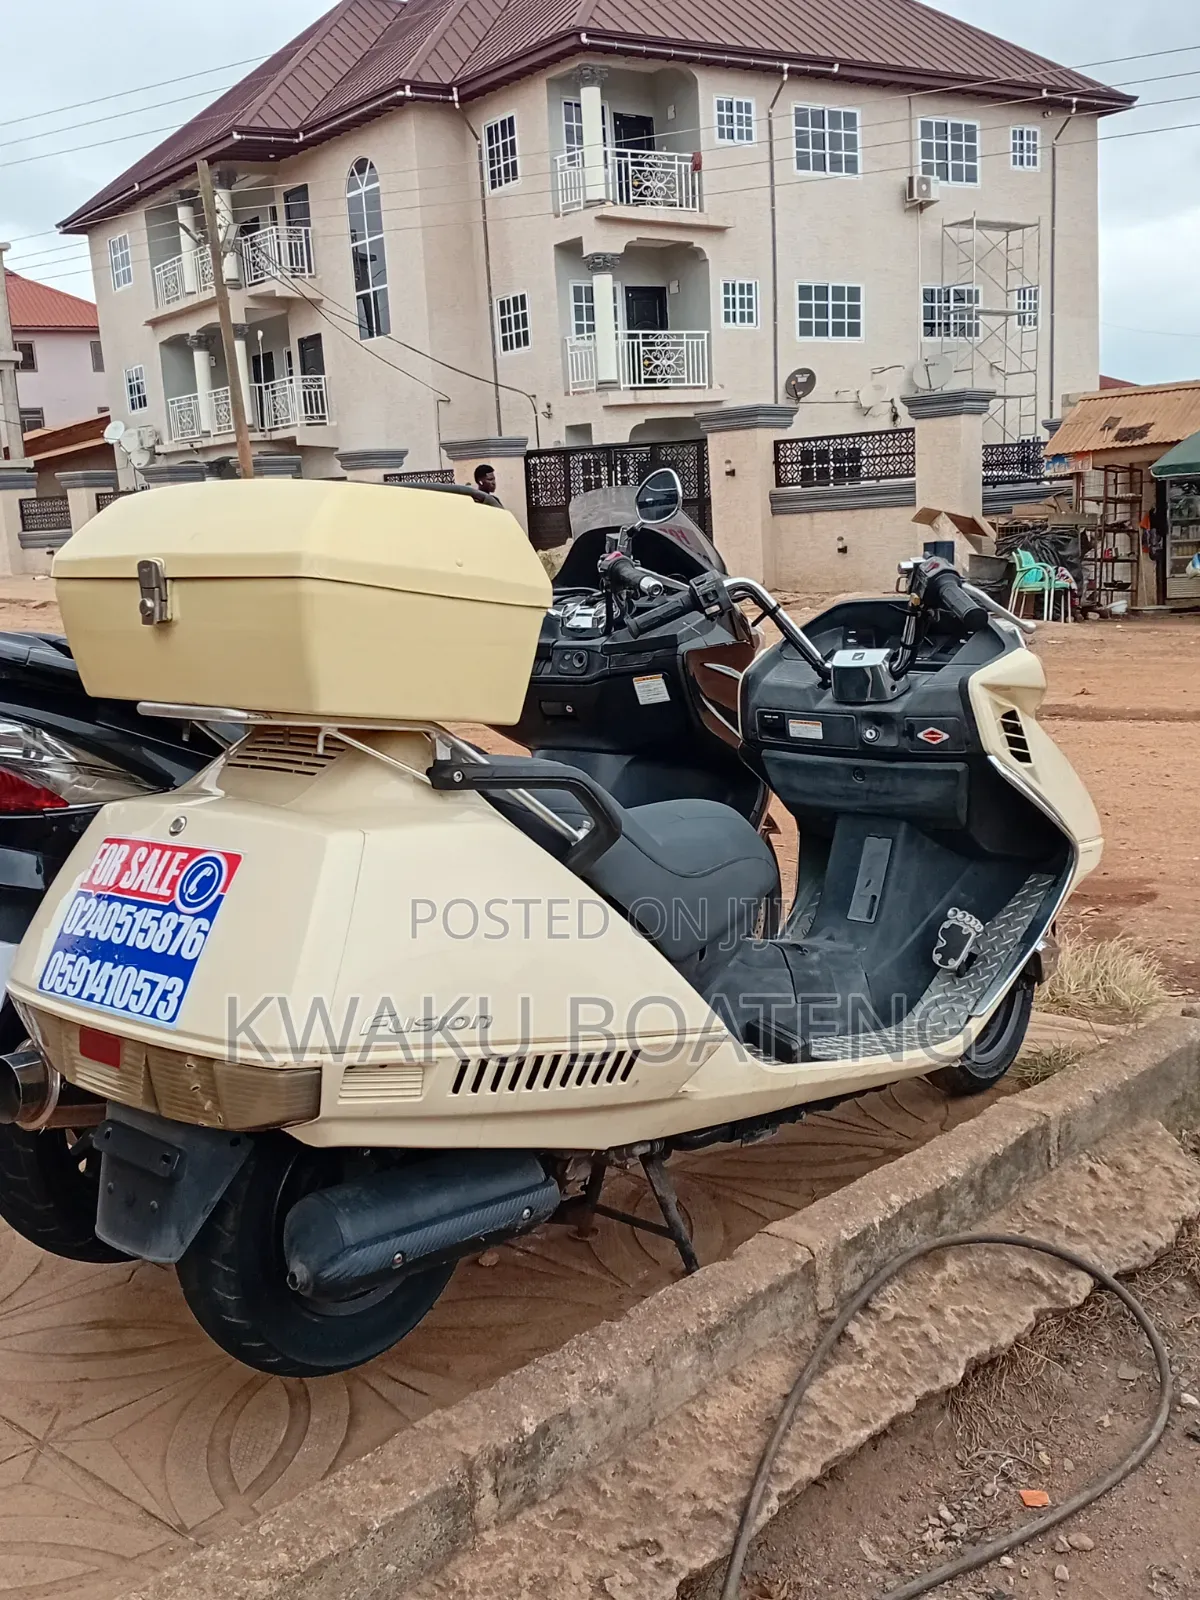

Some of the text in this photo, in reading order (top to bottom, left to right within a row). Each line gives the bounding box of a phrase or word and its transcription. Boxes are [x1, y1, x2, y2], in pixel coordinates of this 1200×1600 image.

[84, 842, 188, 897] FOR SALE
[63, 896, 211, 960] 0240515876
[42, 951, 184, 1021] 0591410573
[360, 1011, 493, 1036] Fusion
